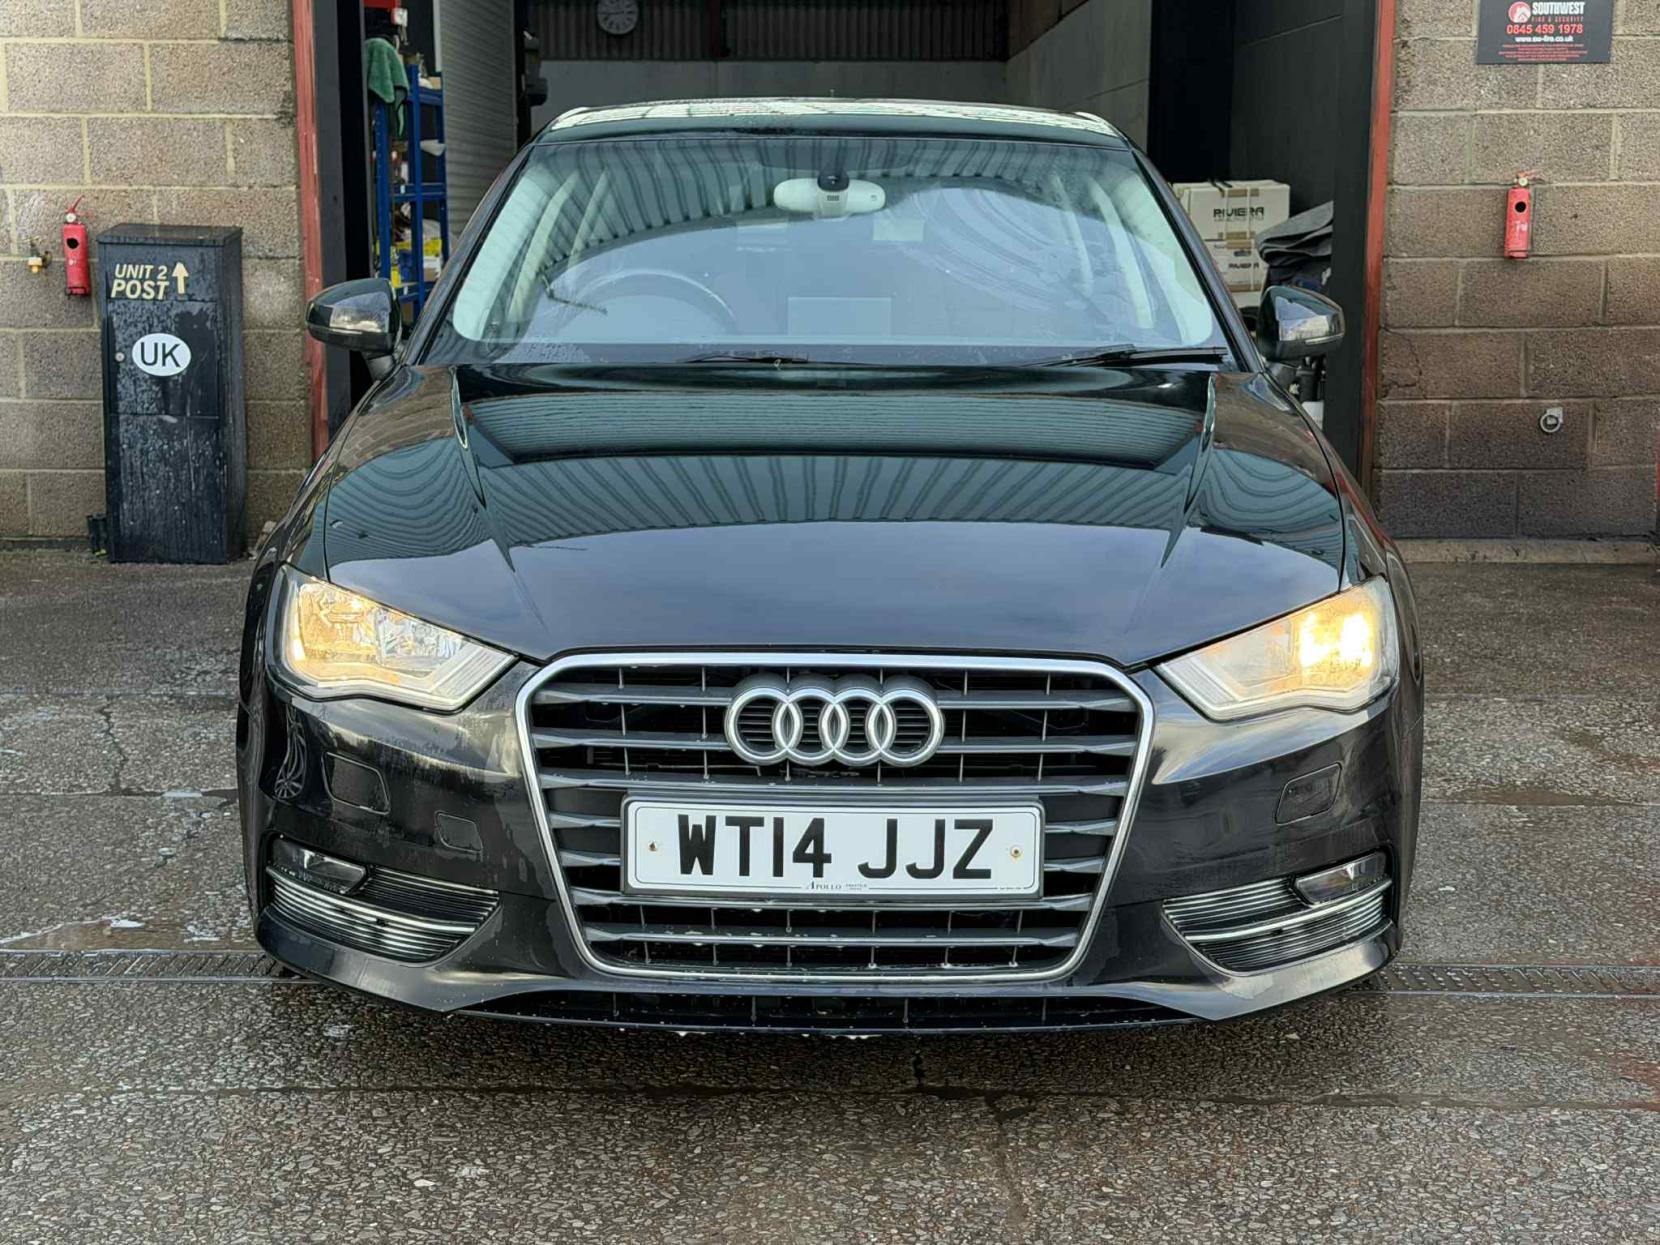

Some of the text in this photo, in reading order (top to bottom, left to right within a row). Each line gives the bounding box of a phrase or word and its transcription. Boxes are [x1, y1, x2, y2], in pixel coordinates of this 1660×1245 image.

[1532, 2, 1585, 15] SOUTHWEST
[1506, 24, 1583, 34] 0845 459 1978
[115, 263, 168, 280] UNIT 2
[110, 279, 169, 300] POST
[140, 342, 181, 368] UK
[677, 814, 994, 880] WT14 JJZ
